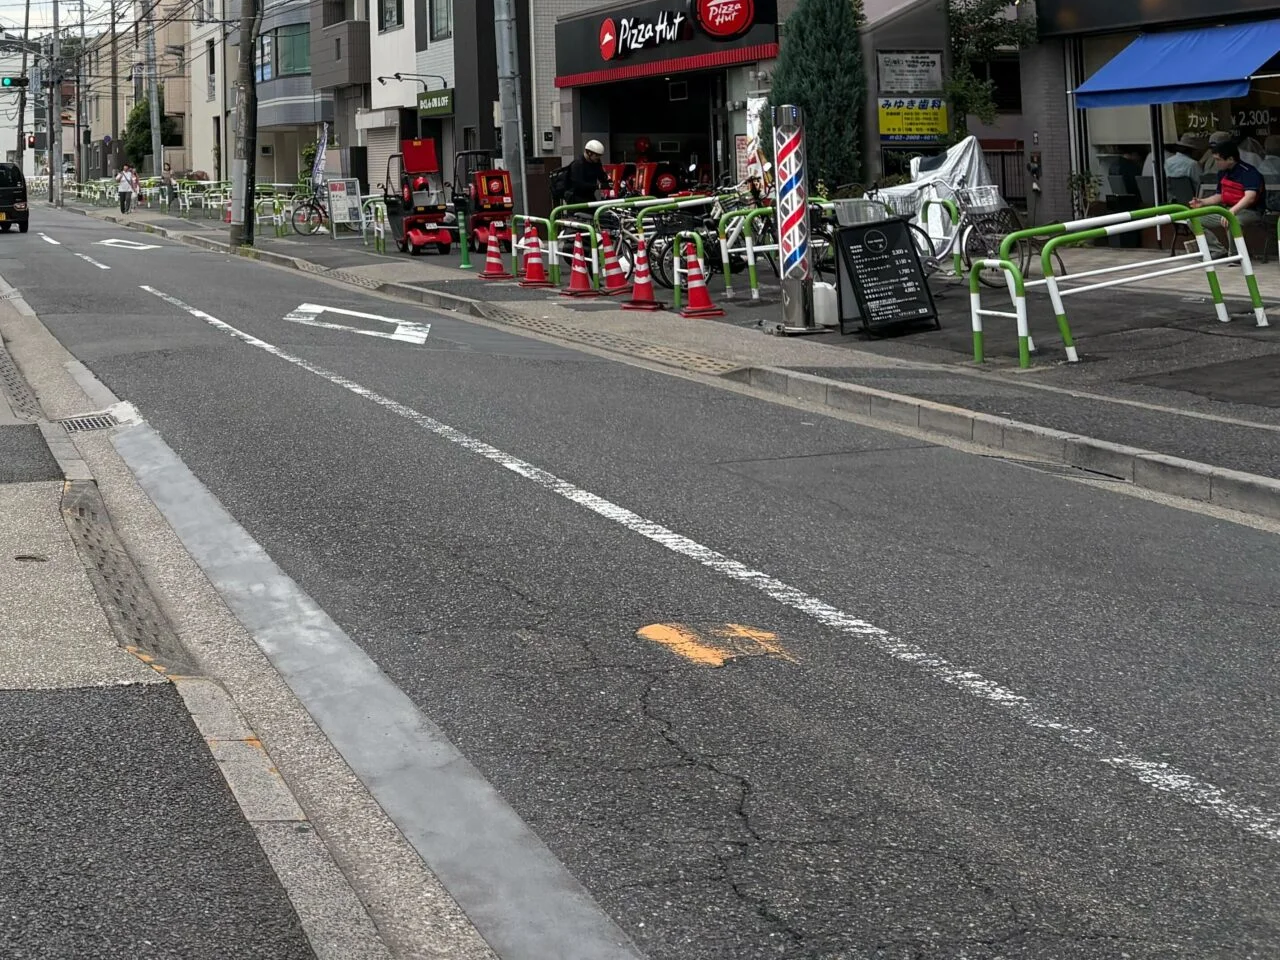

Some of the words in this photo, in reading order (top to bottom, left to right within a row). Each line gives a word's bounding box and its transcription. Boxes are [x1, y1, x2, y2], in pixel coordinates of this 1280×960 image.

[709, 3, 741, 21] Pizza
[715, 12, 738, 26] Hut
[618, 17, 653, 54] Pizza
[655, 11, 684, 44] Hut
[881, 99, 942, 110] みゆき歯科
[1188, 112, 1219, 128] カット
